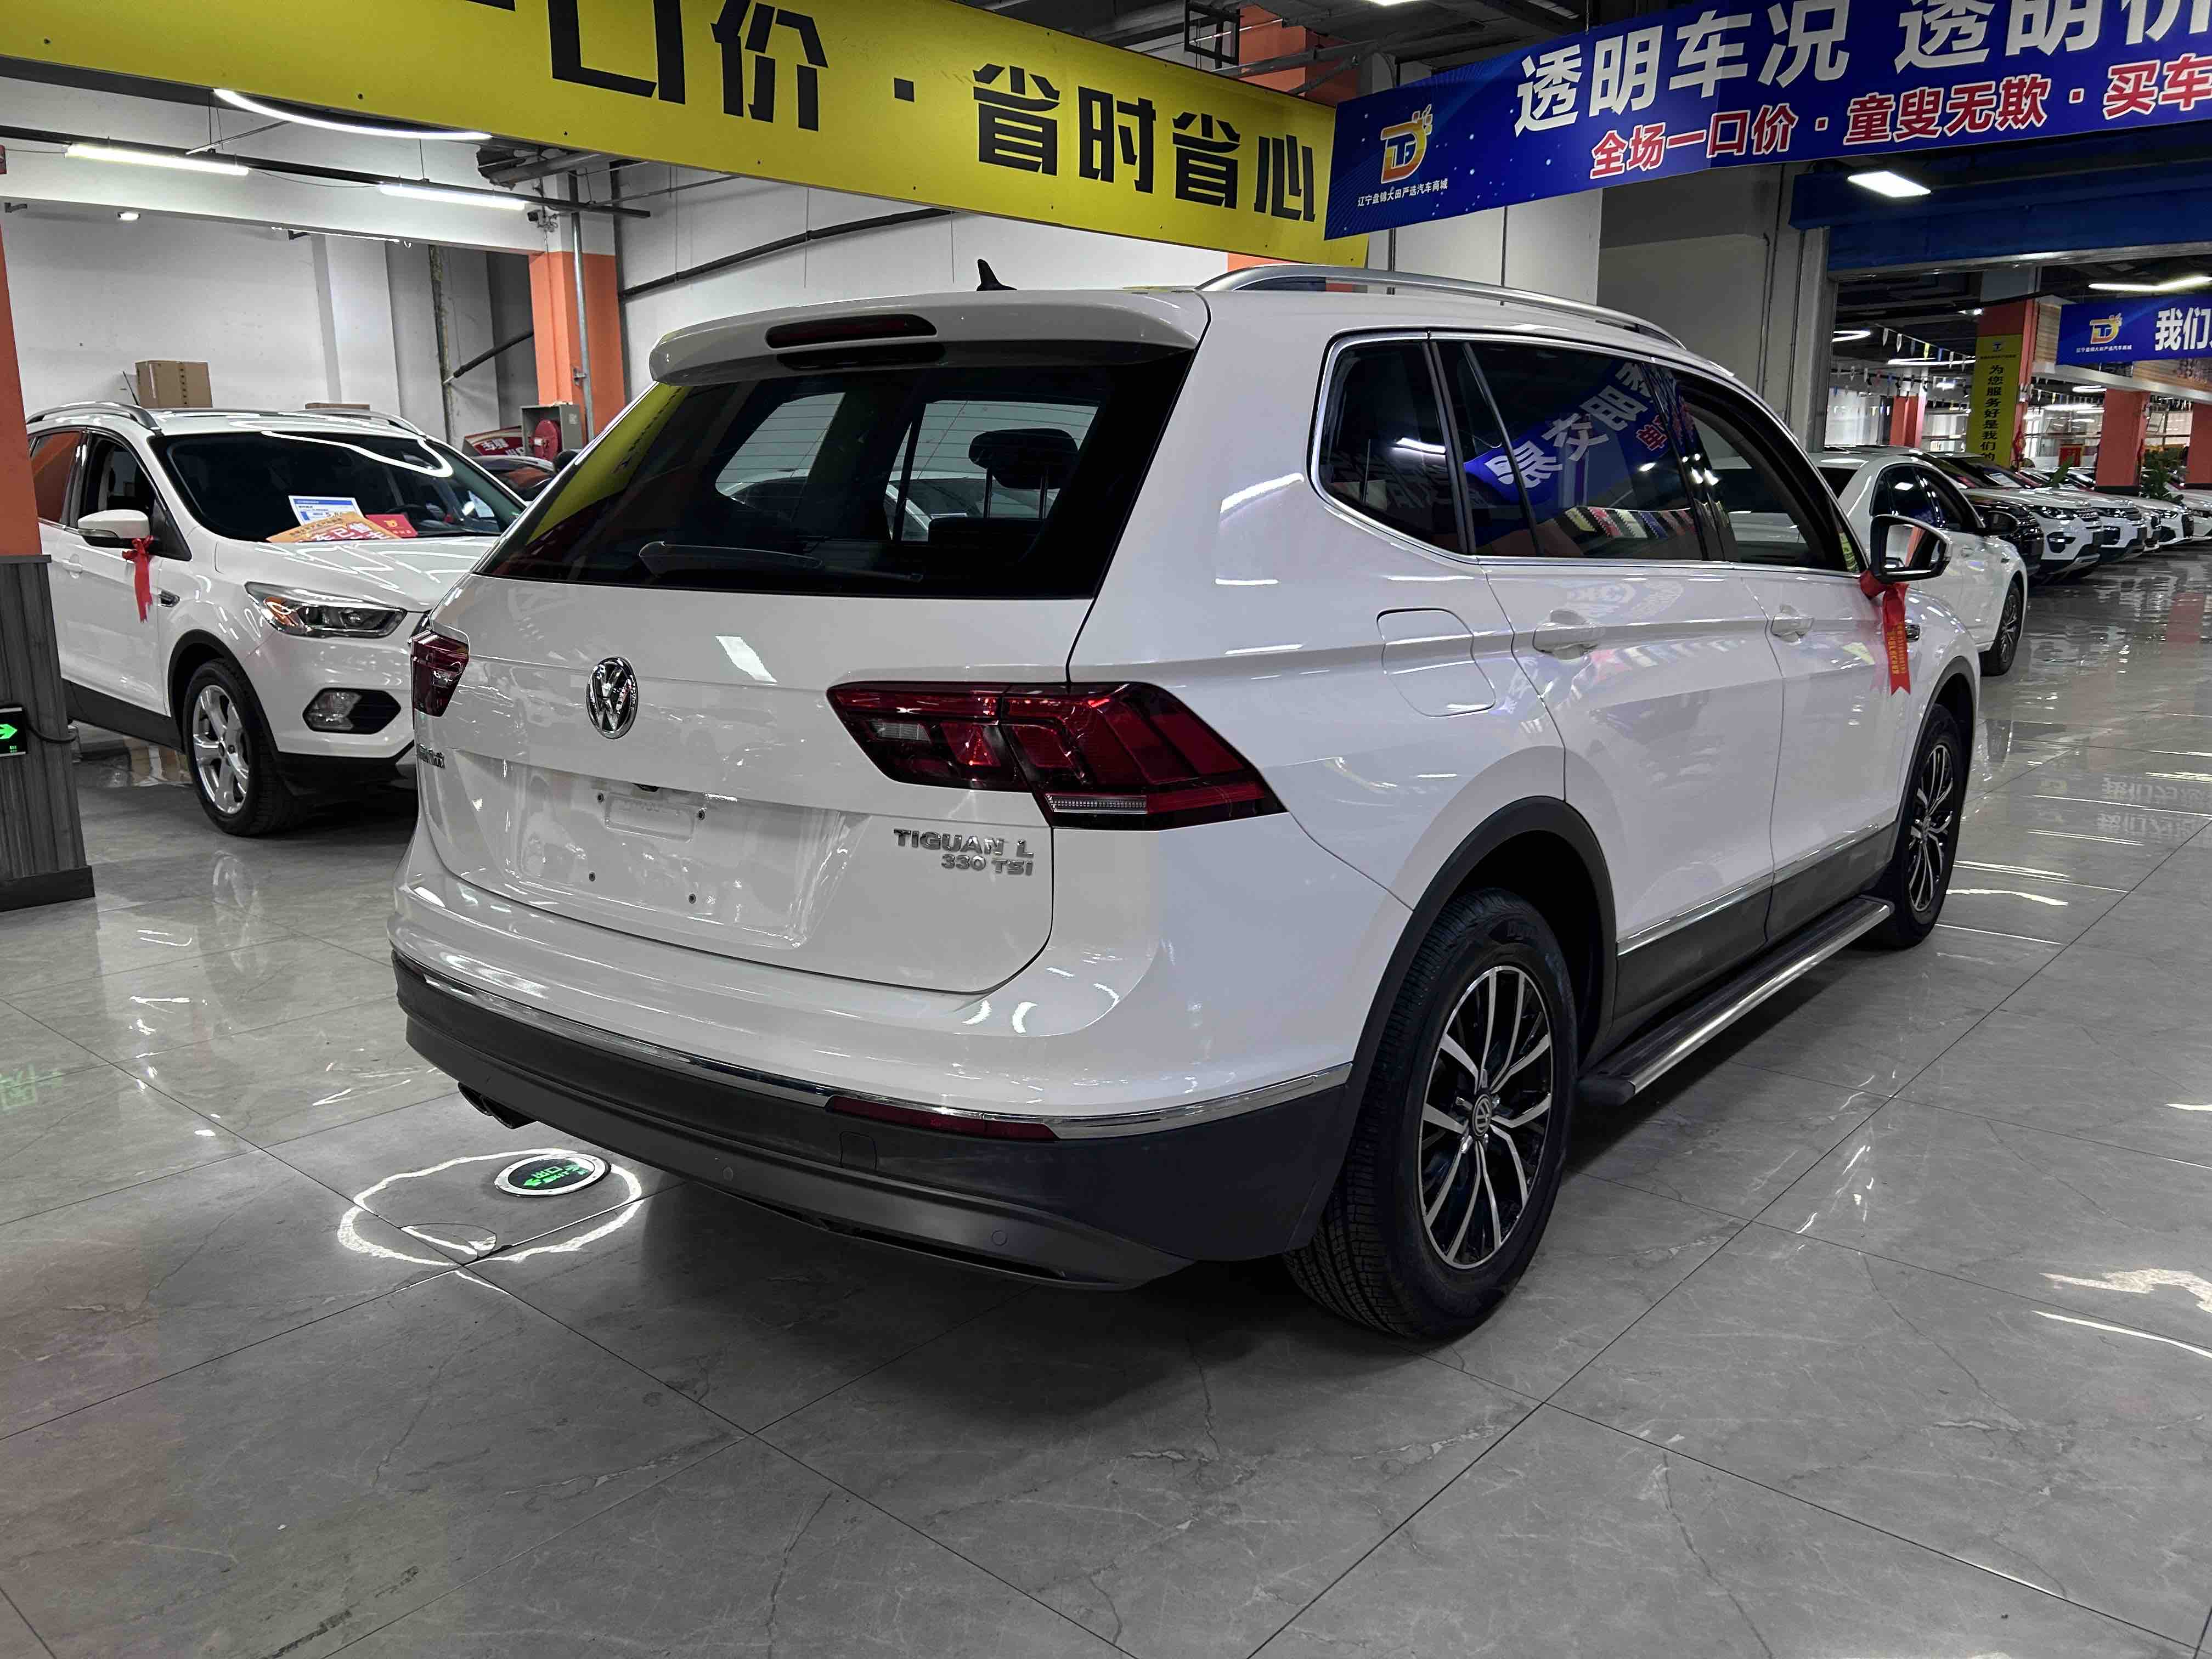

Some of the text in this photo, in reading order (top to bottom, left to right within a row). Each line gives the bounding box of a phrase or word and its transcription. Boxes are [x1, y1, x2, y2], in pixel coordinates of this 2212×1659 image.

[1514, 0, 1850, 137] 透明车况
[1357, 178, 1448, 207] 辽宁盘锦大田严选汽车商城
[2154, 307, 2212, 352] 我们
[893, 828, 1034, 858] TIGUAN L
[941, 854, 1034, 876] 330 TSI
